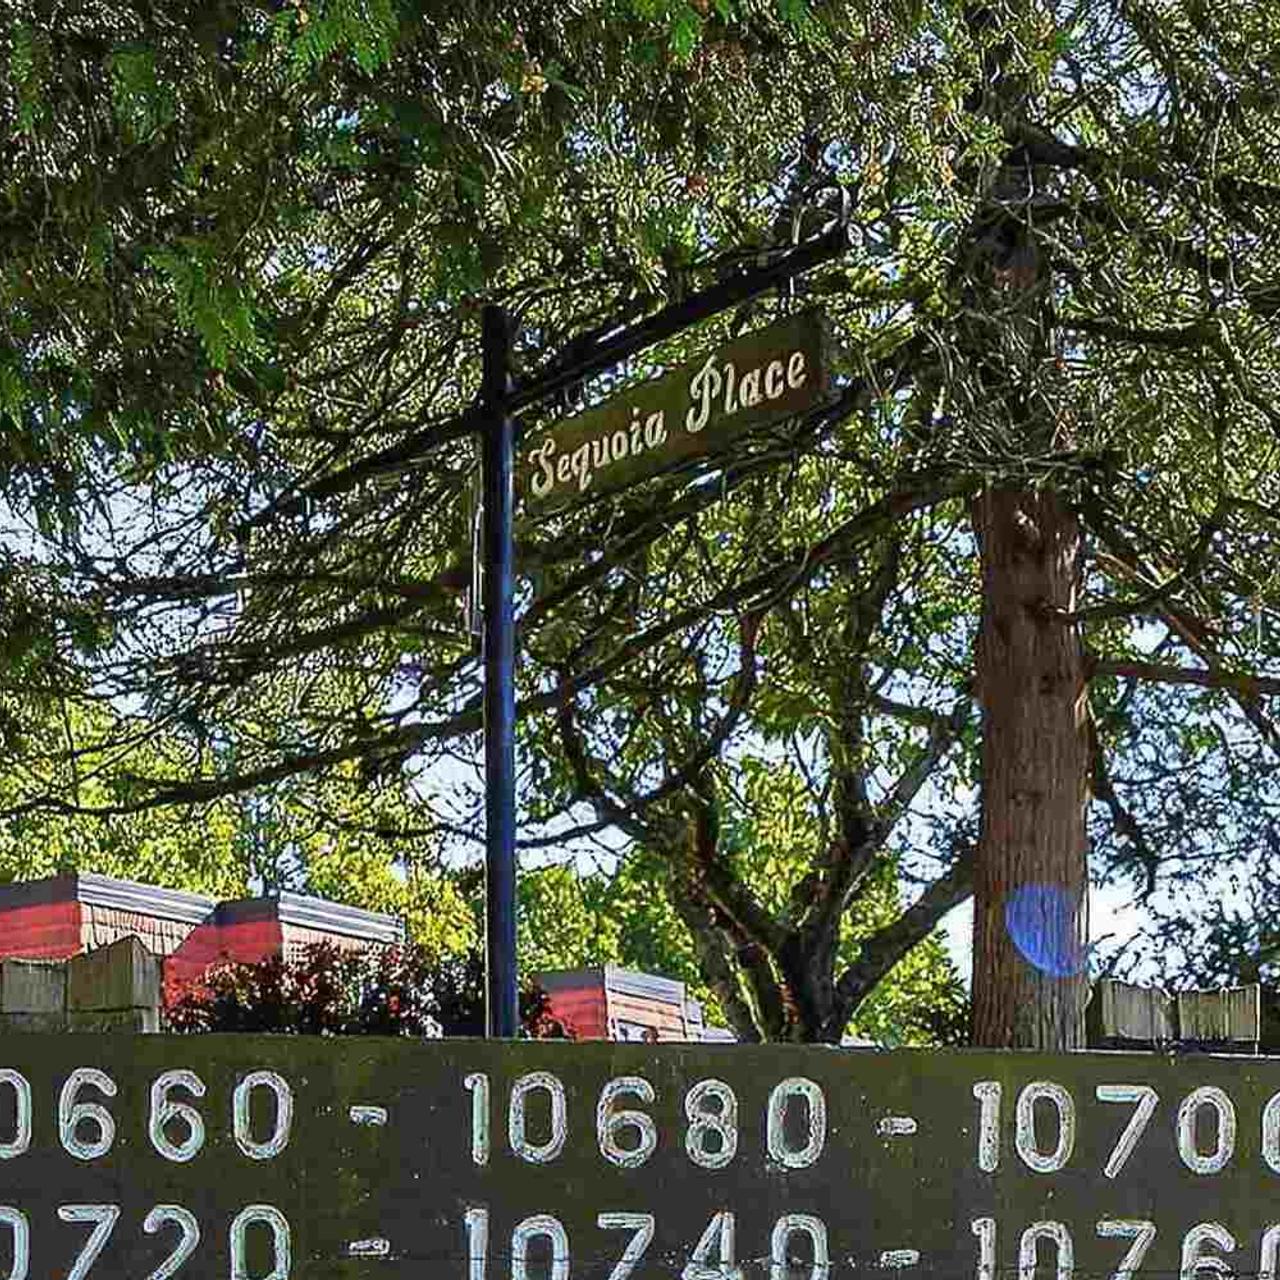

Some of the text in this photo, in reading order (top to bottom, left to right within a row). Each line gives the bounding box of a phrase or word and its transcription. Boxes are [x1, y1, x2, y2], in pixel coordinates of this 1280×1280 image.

[528, 351, 807, 497] Sequoia Place
[463, 1072, 828, 1169] 10680
